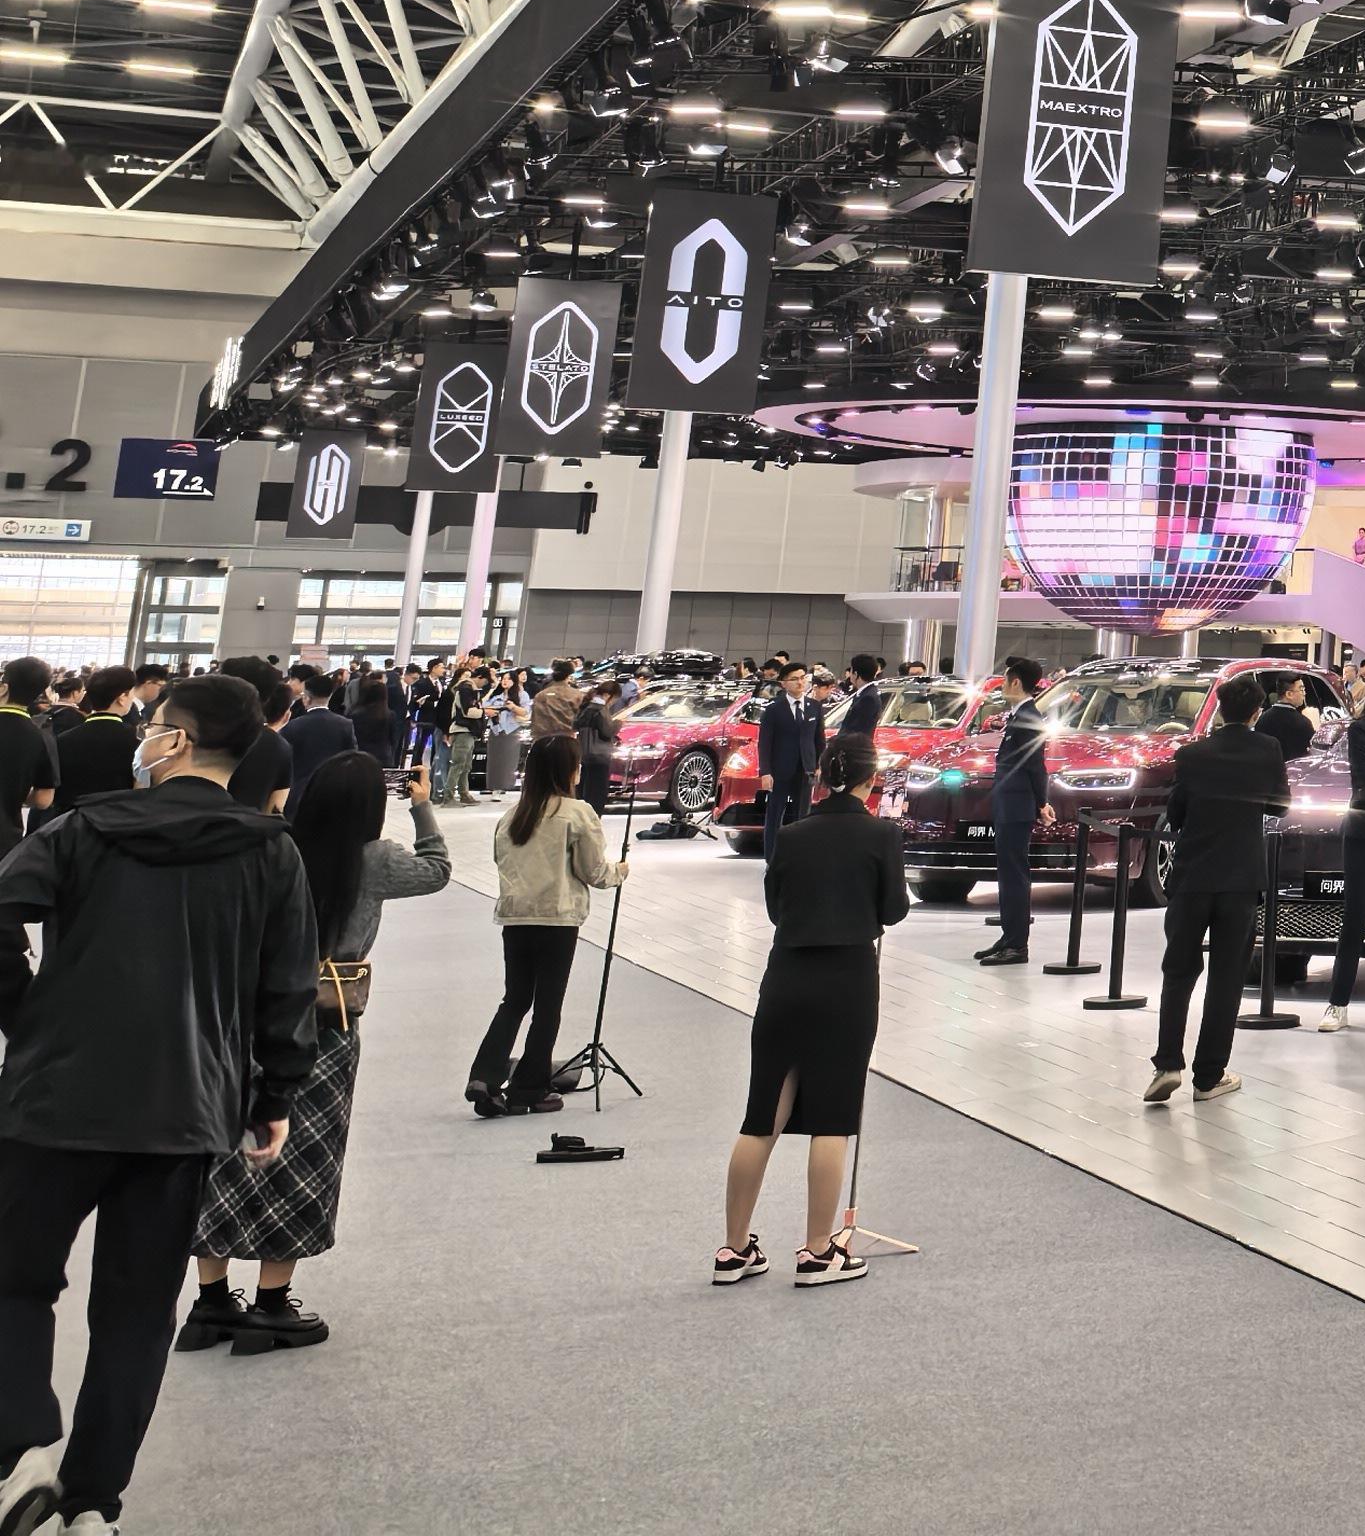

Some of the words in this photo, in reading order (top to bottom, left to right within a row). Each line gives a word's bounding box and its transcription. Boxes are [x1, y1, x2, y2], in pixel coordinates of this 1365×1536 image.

[1039, 98, 1123, 119] MAEXTRO
[667, 294, 743, 308] AITO
[531, 363, 589, 373] STELATO
[4, 438, 91, 492] .2
[153, 468, 204, 491] 17.2
[22, 524, 47, 535] 17.2
[1320, 879, 1344, 894] 问界
